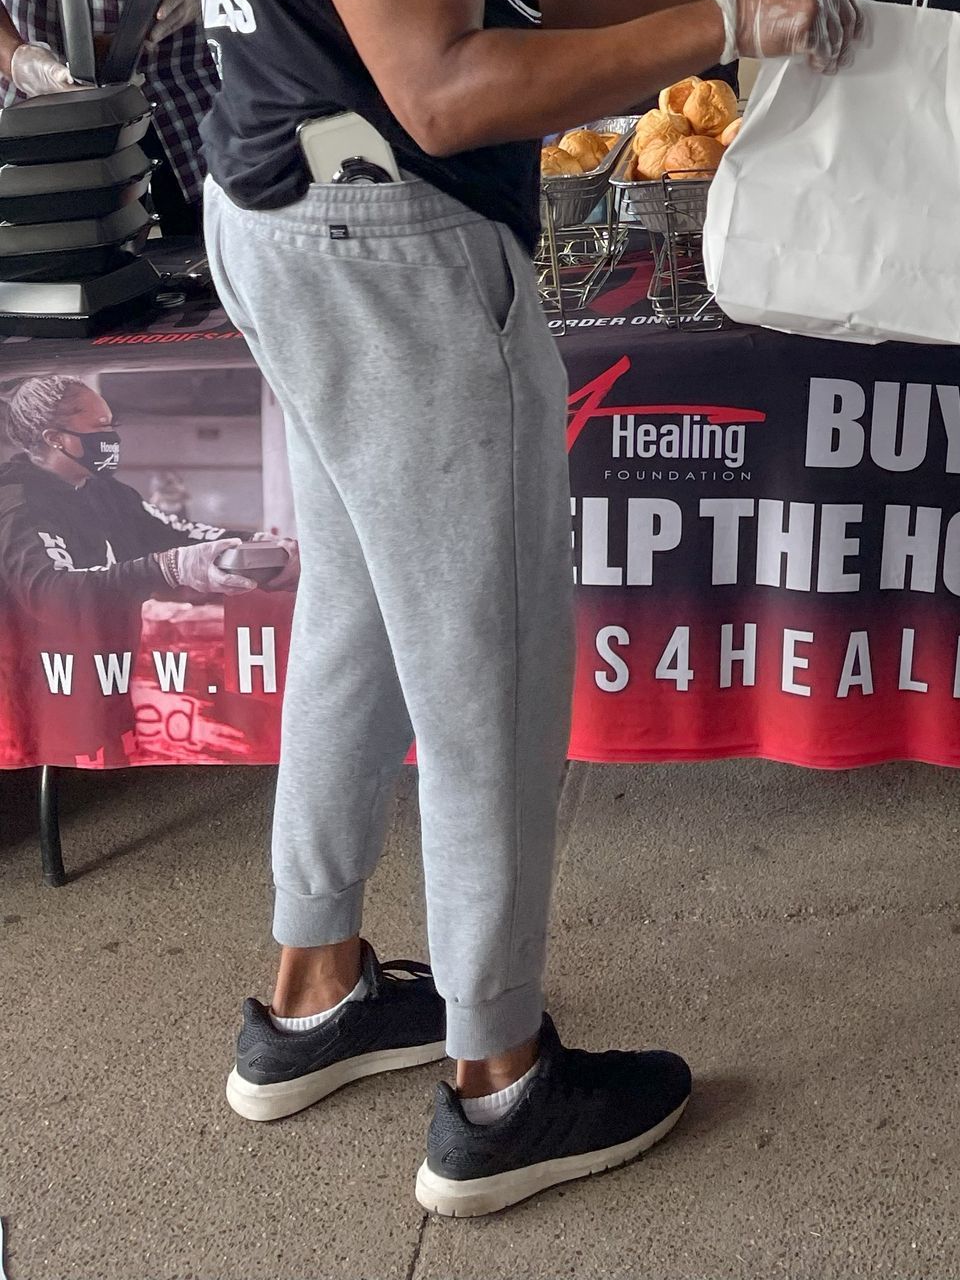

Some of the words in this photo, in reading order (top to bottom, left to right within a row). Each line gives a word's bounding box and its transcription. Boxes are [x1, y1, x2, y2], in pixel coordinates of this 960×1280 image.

[547, 317, 625, 329] ORDER
[612, 414, 746, 468] Healing
[604, 470, 752, 481] FOUNDATION
[699, 498, 863, 593] THE
